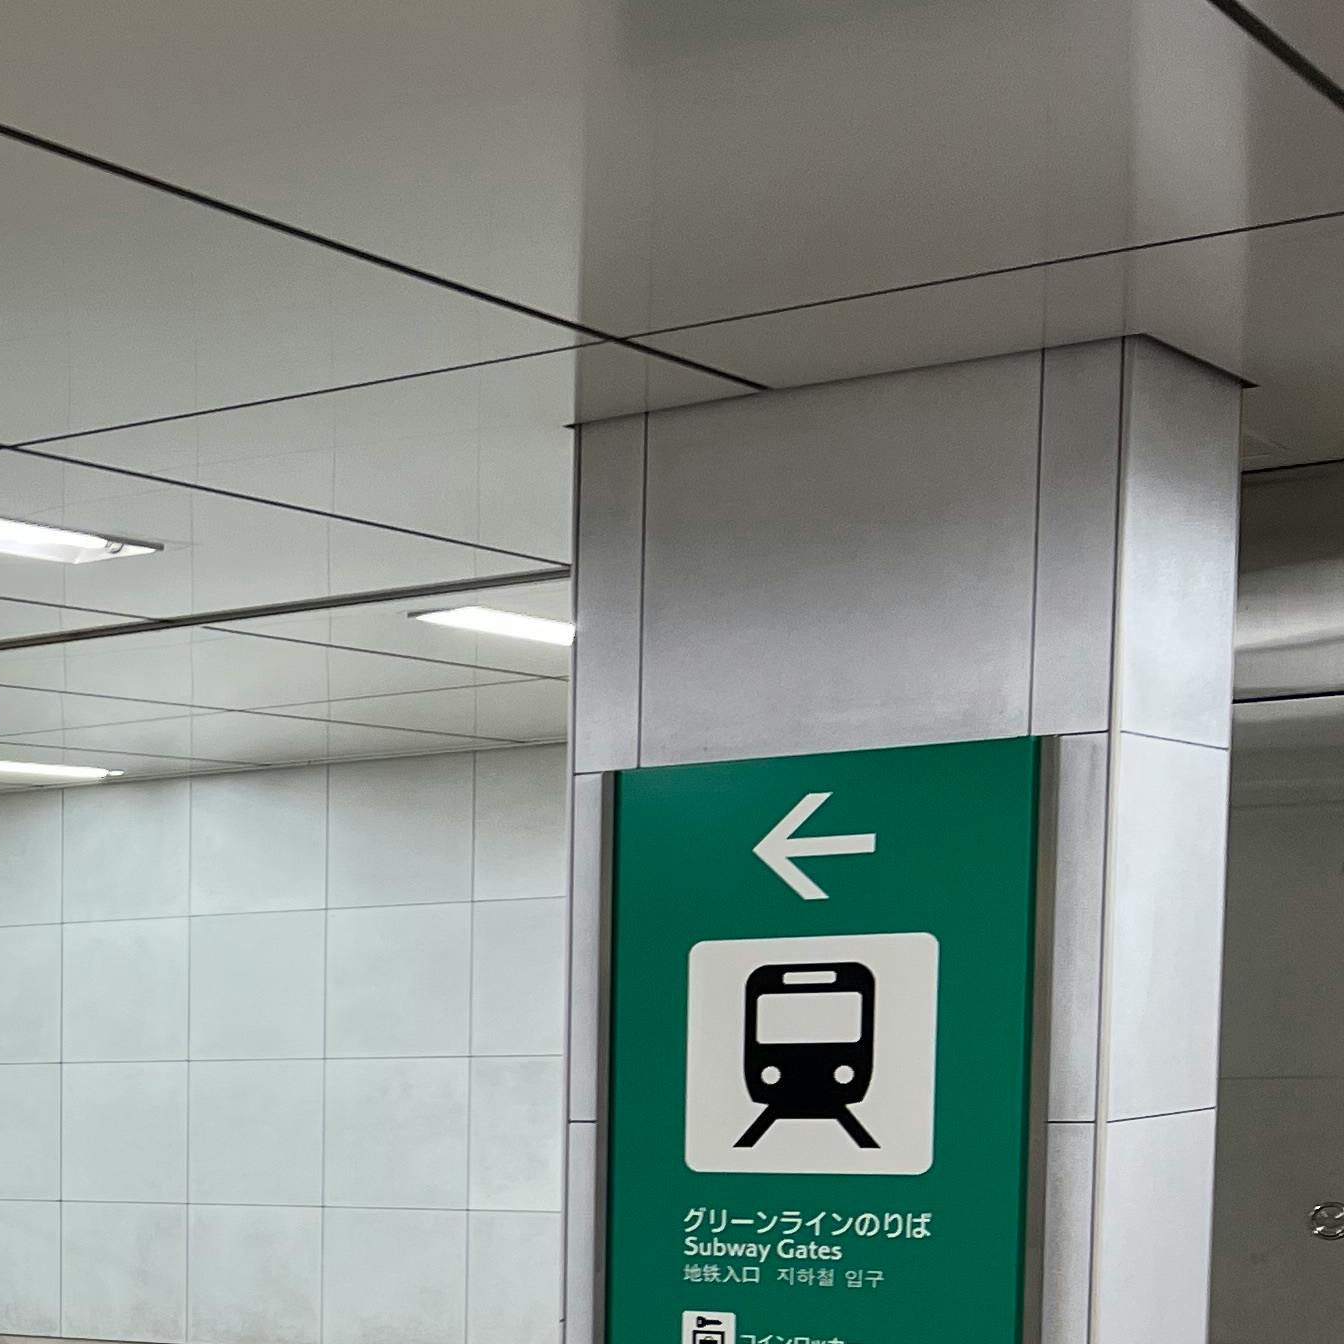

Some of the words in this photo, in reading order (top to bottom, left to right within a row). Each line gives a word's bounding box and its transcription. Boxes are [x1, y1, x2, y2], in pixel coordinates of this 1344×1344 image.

[682, 1207, 933, 1240] グリーンラインのりば
[683, 1236, 772, 1263] Subway
[776, 1238, 843, 1261] Gates
[682, 1264, 761, 1284] 地铁入口
[776, 1267, 835, 1288] 지하철
[844, 1269, 885, 1289] 입구
